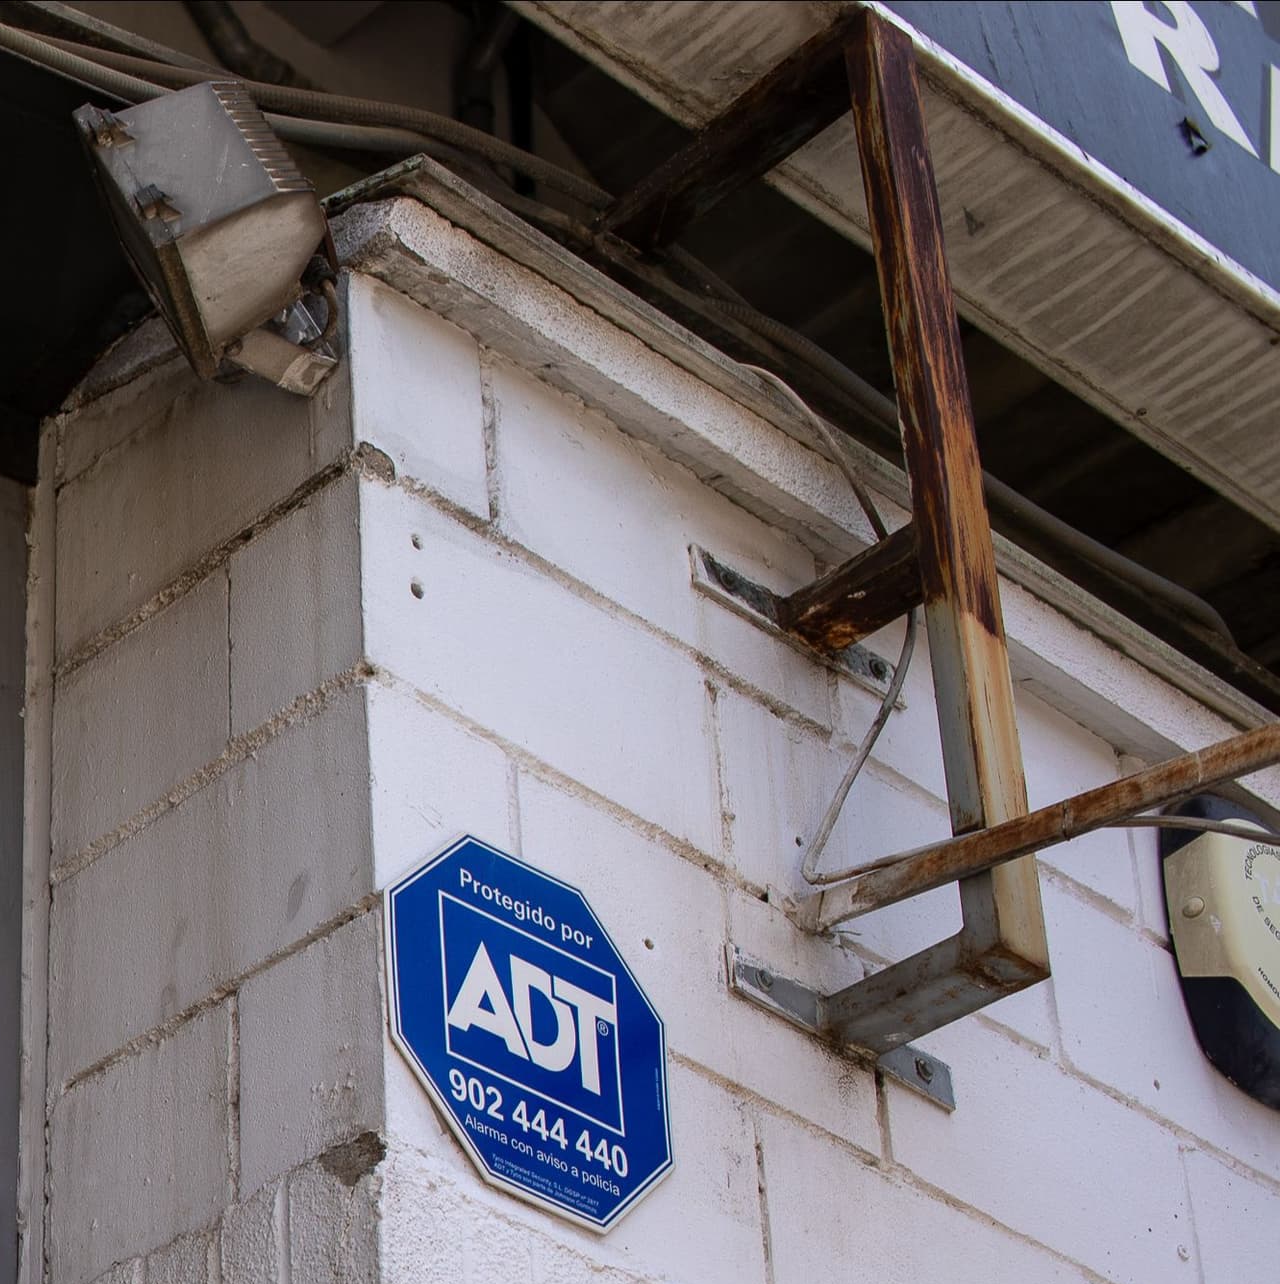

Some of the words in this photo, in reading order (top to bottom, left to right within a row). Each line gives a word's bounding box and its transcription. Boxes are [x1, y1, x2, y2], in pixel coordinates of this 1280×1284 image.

[459, 868, 555, 931] Protegido
[561, 923, 593, 949] por
[448, 941, 615, 1096] ADT
[449, 1069, 504, 1121] 902
[512, 1101, 568, 1149] 444
[576, 1132, 629, 1178] 440
[465, 1113, 508, 1145] Alarma
[511, 1137, 533, 1158] con
[536, 1148, 567, 1173] aviso
[571, 1166, 579, 1178] a
